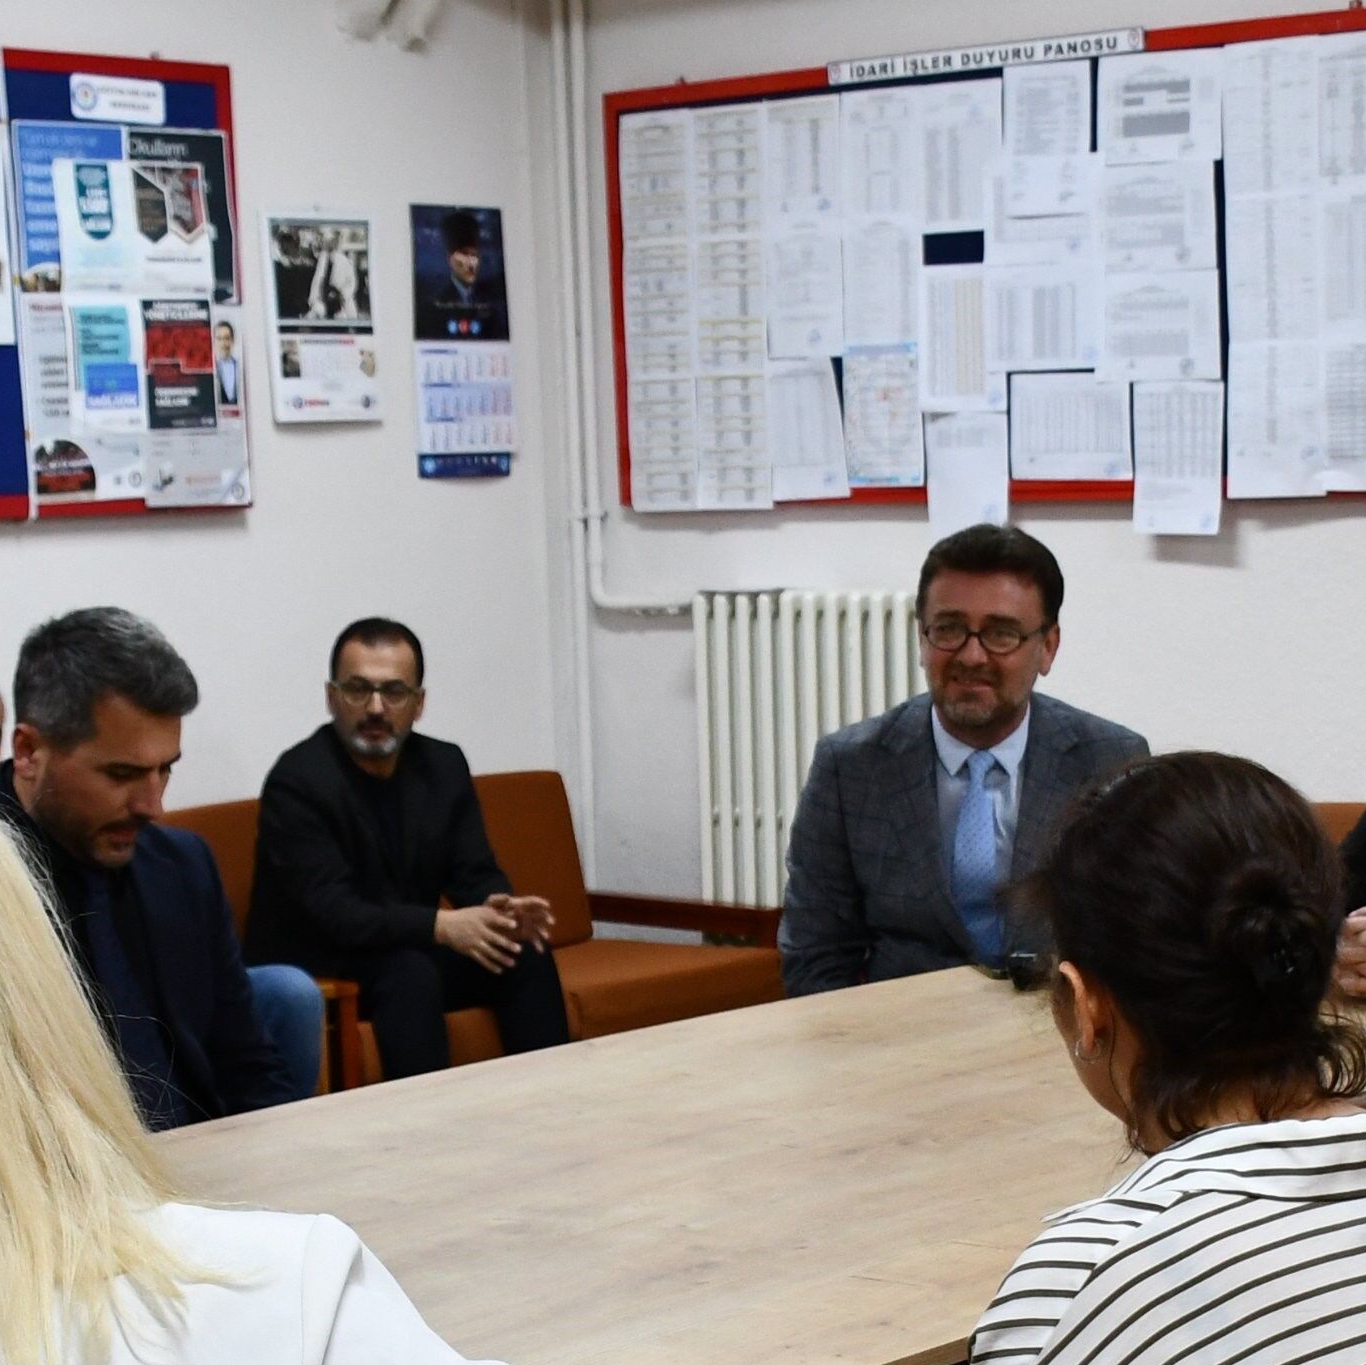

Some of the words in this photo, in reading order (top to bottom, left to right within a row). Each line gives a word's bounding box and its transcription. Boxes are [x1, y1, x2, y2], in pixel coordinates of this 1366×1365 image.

[849, 61, 896, 79] İDARİ
[902, 57, 953, 77] İŞLER
[960, 44, 1035, 66] DUYURU
[1043, 36, 1119, 58] PANOSU
